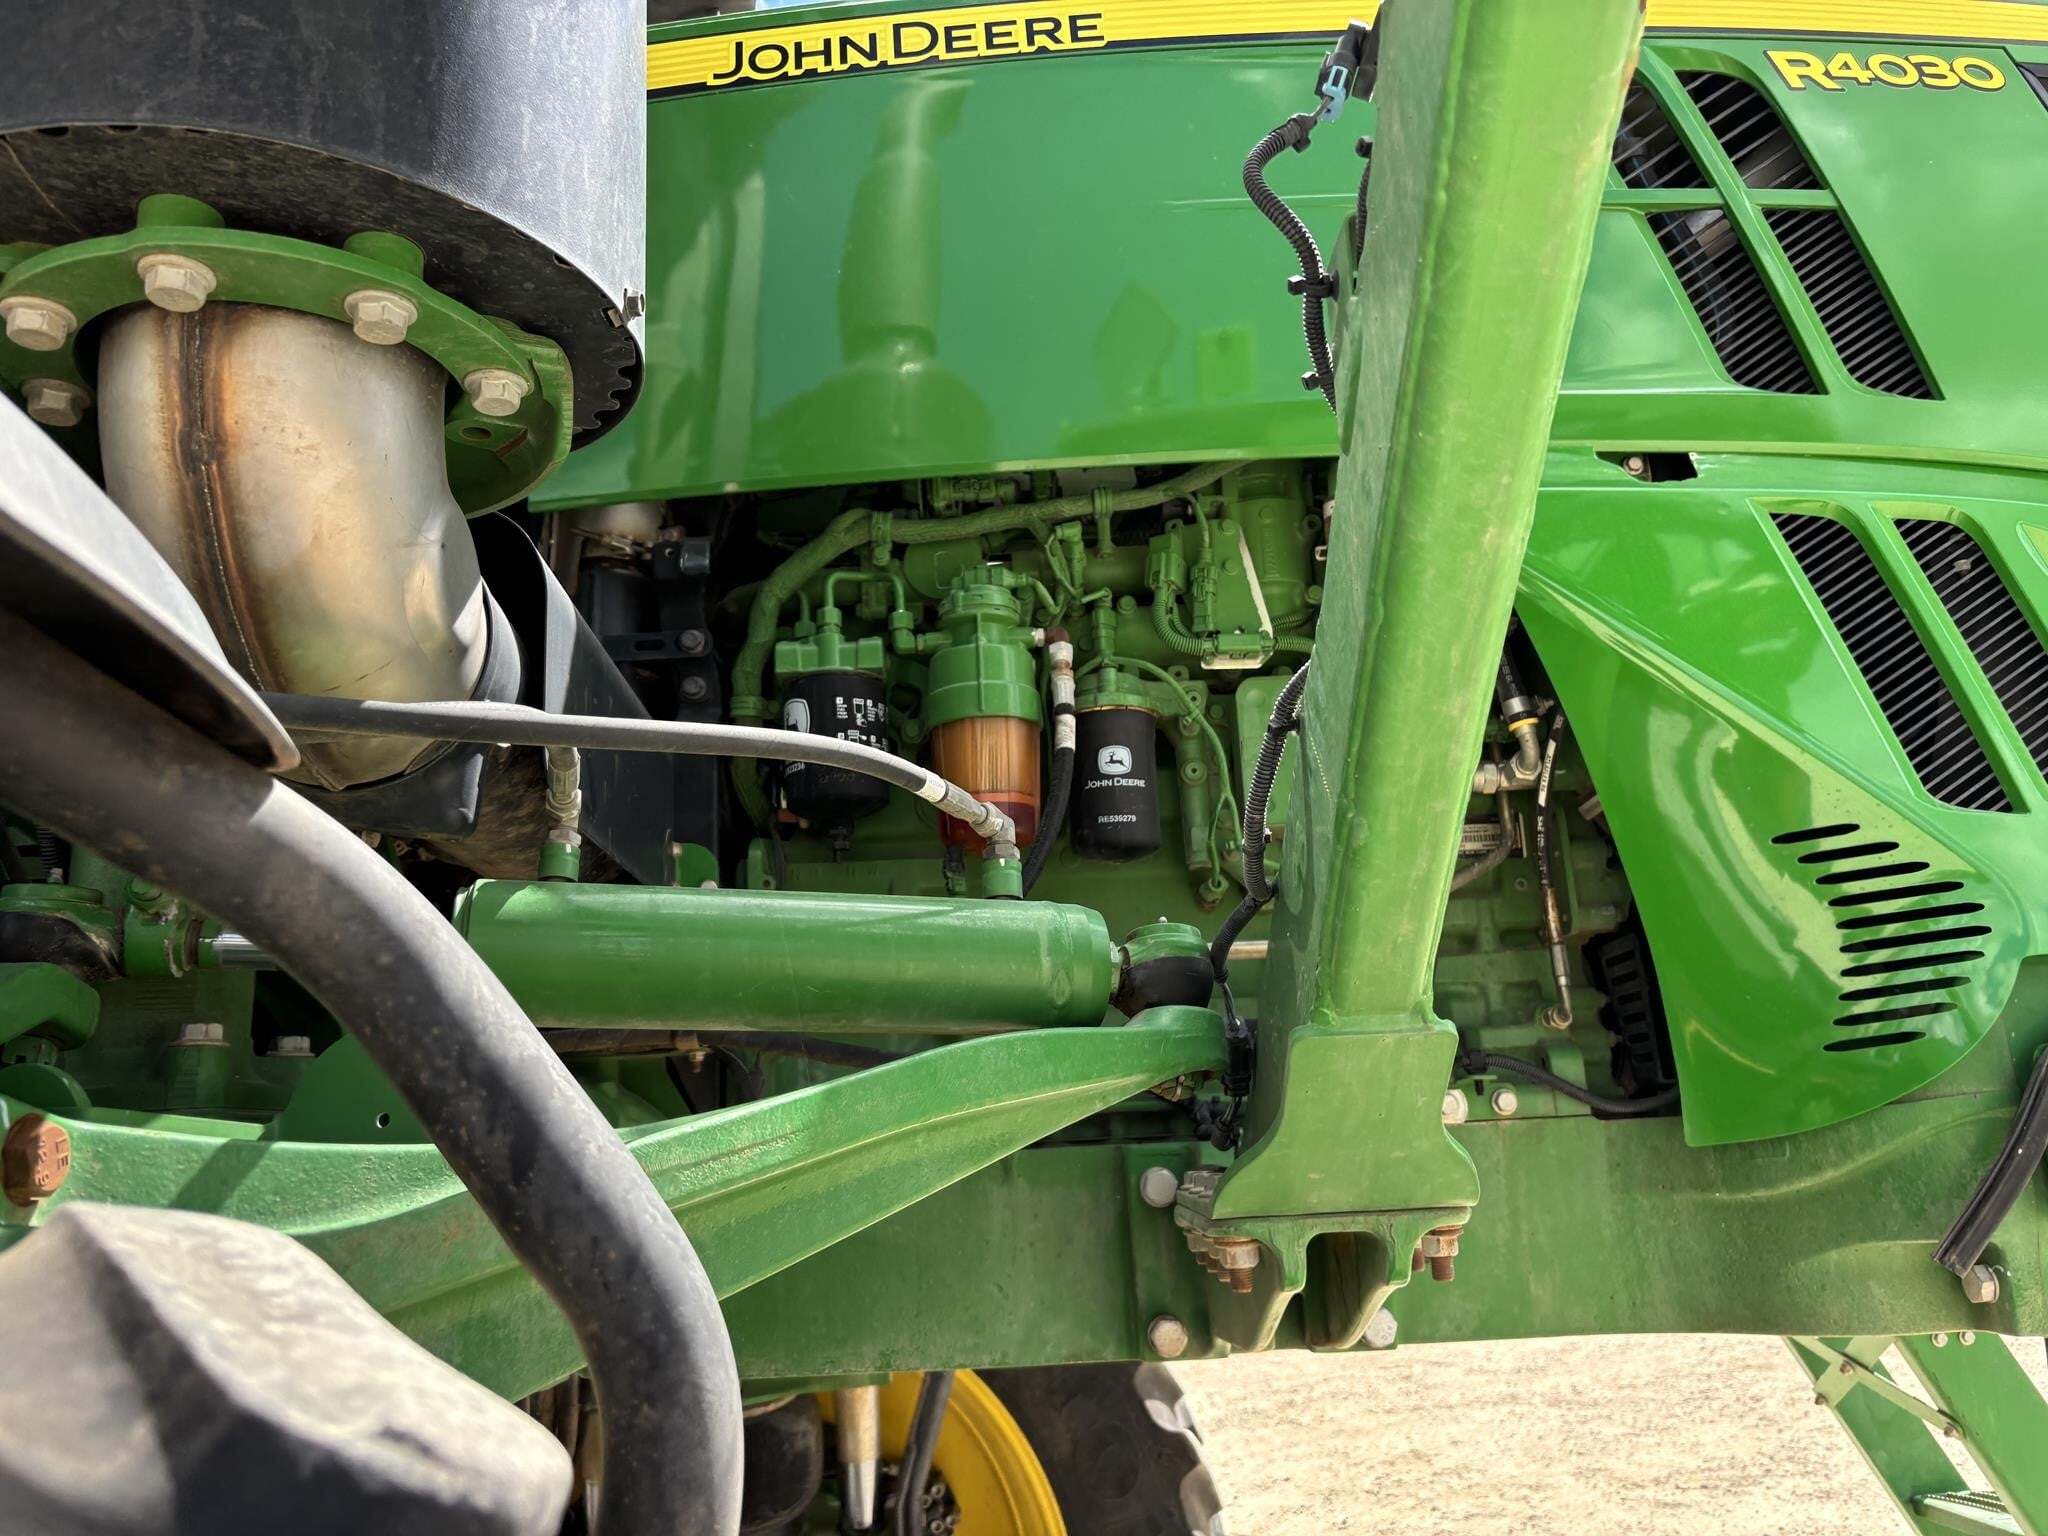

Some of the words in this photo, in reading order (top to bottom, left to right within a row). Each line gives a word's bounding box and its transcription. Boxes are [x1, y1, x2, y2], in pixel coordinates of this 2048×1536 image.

[712, 32, 878, 80] JOHN
[891, 13, 1105, 61] DEERE
[1763, 49, 2007, 92] R4030
[1084, 778, 1113, 790] JOHN
[1113, 777, 1147, 788] DEERE
